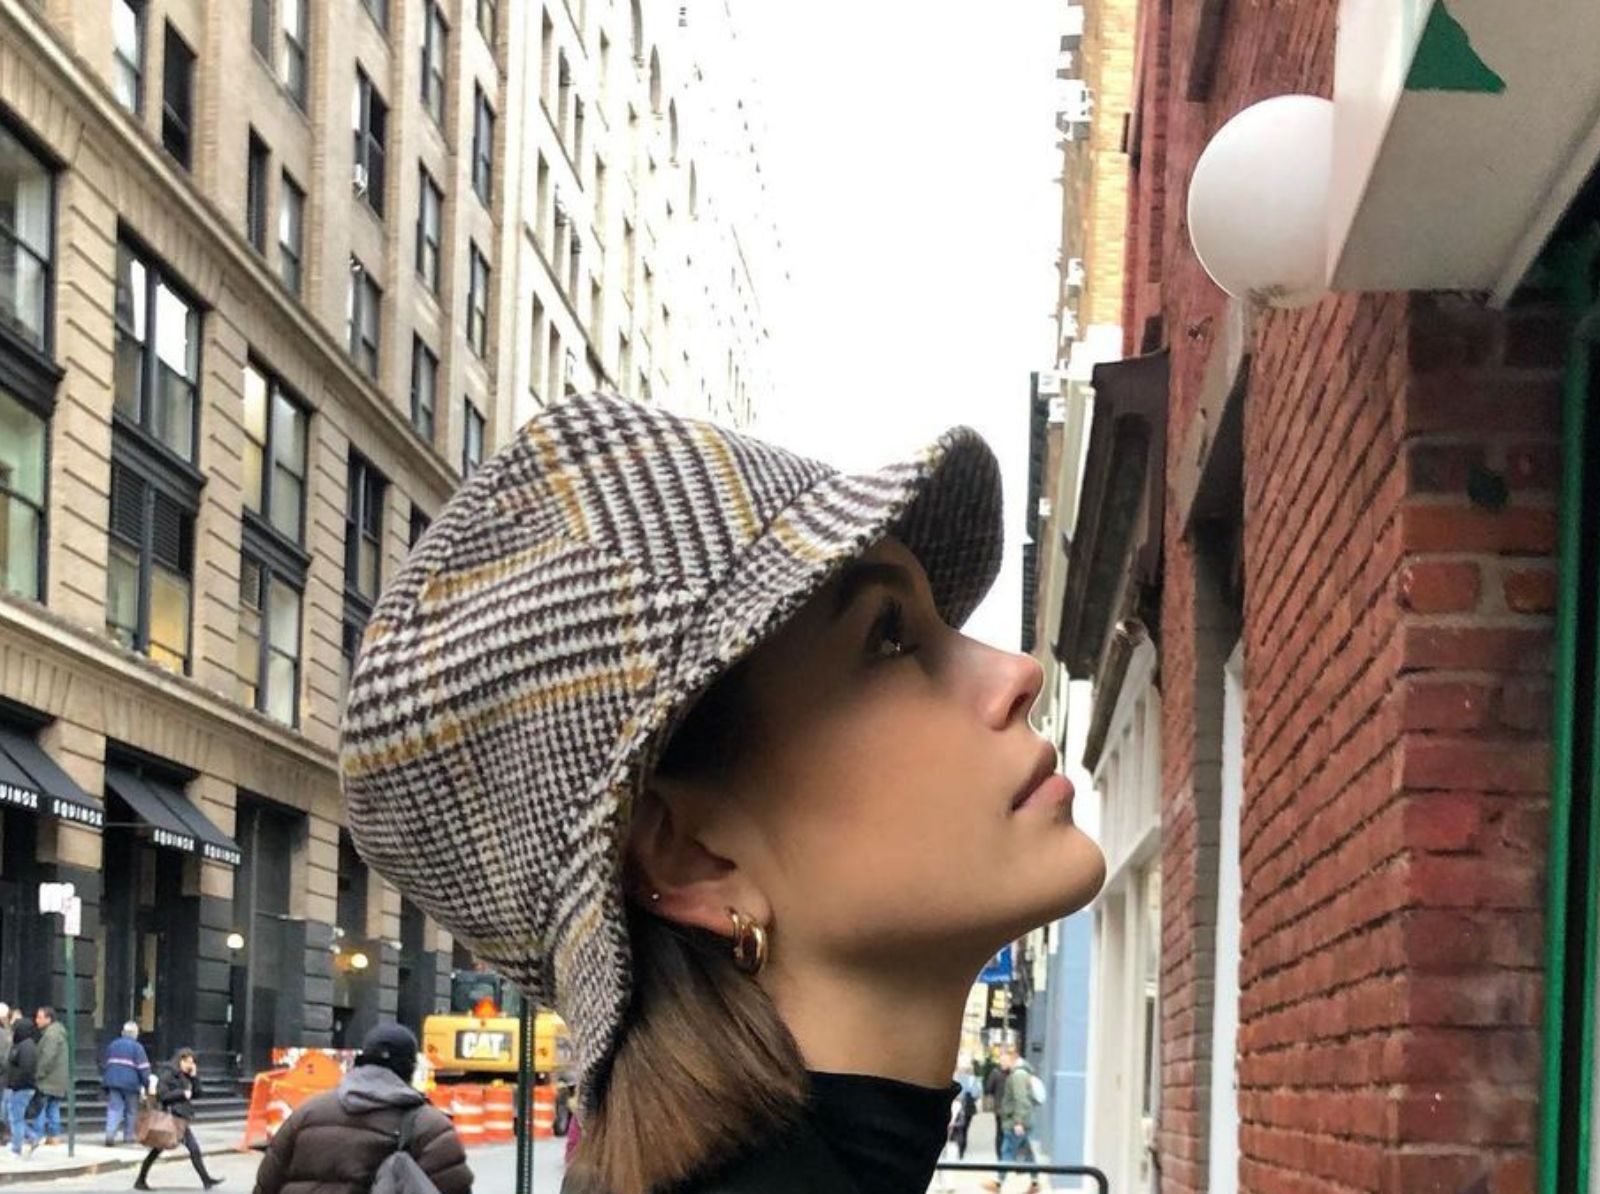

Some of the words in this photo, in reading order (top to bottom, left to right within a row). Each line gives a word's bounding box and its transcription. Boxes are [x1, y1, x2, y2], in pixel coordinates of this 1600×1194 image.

[53, 798, 103, 826] EQUINOX
[153, 828, 195, 851] EQUINOX
[461, 1031, 505, 1058] CAT
